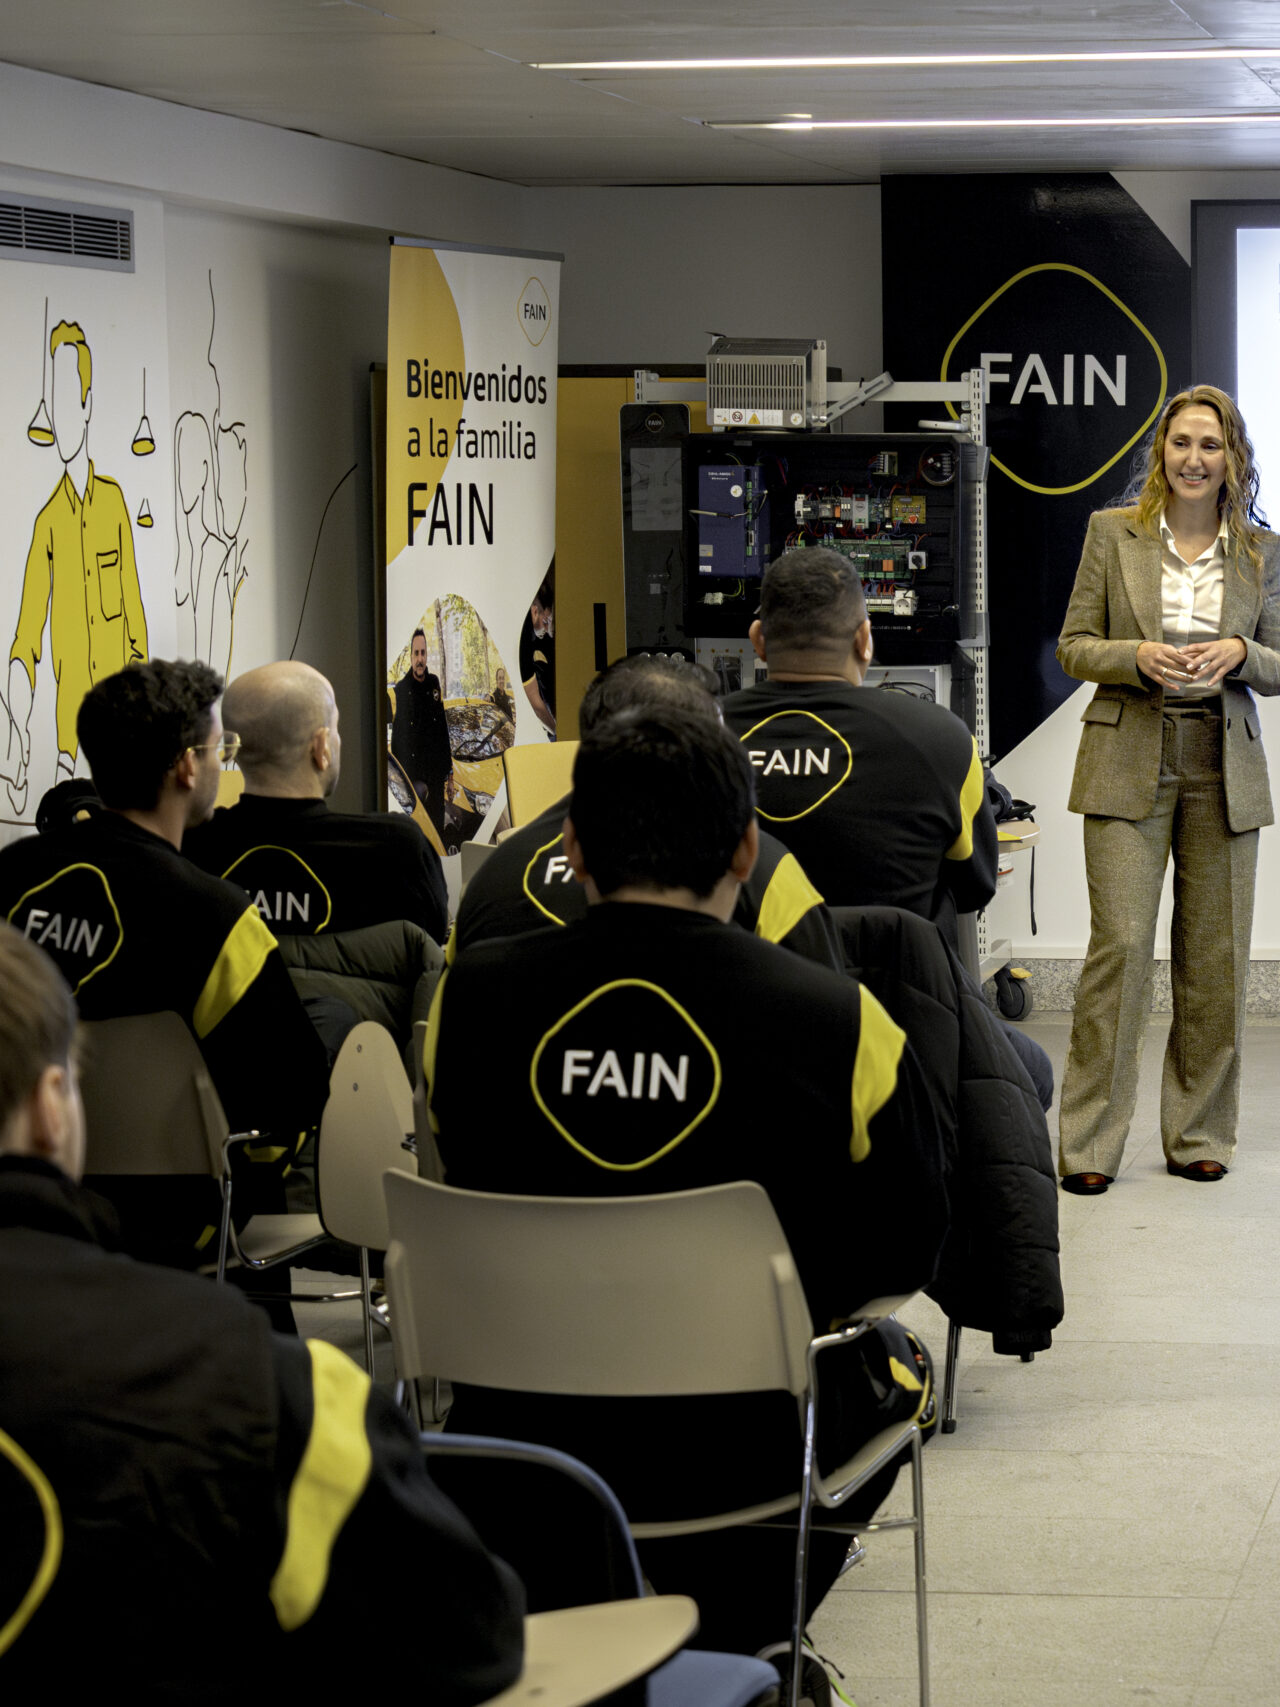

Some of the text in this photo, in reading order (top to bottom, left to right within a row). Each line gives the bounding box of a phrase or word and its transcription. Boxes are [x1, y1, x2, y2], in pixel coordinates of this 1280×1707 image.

[523, 303, 547, 321] FAIN
[406, 358, 547, 405] Bienvenidos
[980, 353, 1126, 406] FAIN
[407, 417, 536, 460] a la familia
[407, 482, 494, 547] FAIN
[748, 747, 831, 777] FAIN
[246, 889, 310, 923] AIN
[23, 908, 104, 959] FAIN
[561, 1049, 689, 1102] FAIN
